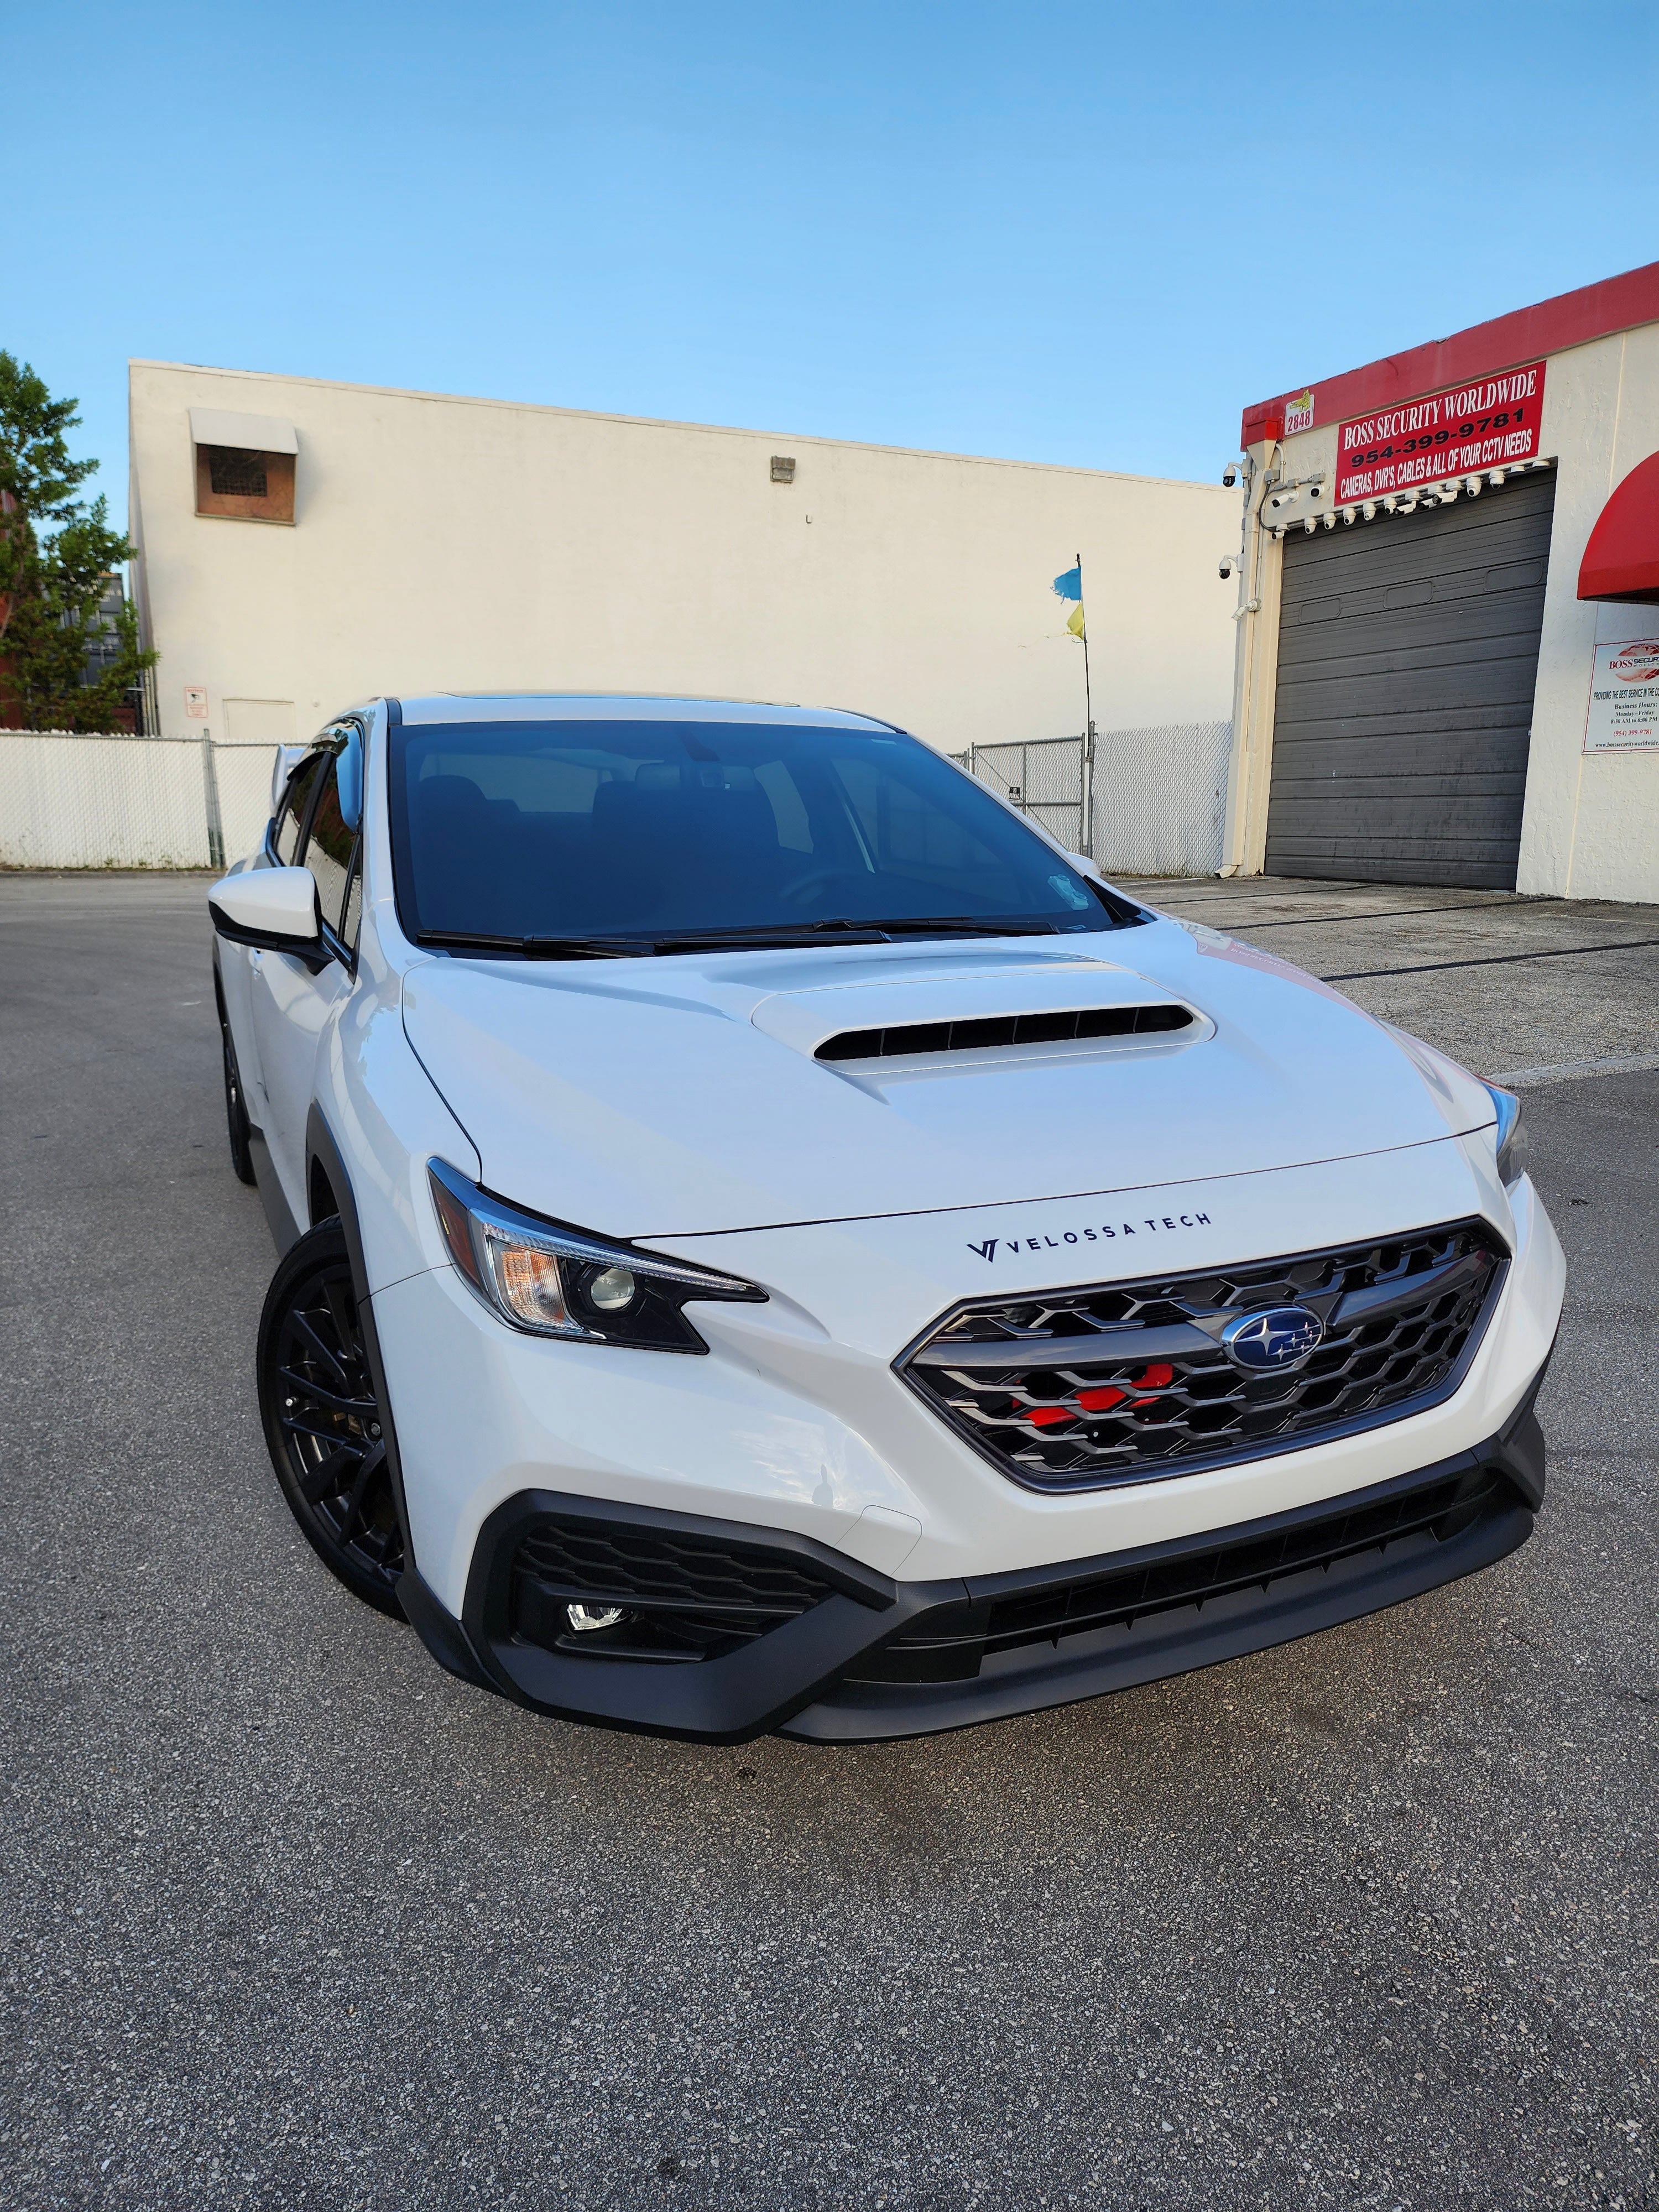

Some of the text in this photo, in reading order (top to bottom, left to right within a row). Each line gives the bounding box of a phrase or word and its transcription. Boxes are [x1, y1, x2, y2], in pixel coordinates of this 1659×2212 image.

[1287, 410, 1311, 432] 2848
[1344, 370, 1537, 450] BOSS SECURITY WORLDWIDE
[1351, 408, 1524, 468] 954-399-9781
[1340, 428, 1532, 499] CAMERAS, DVR'S, CABLES & ALL OF YOUR CCTV NEEDS
[1609, 659, 1633, 669] BOSS
[1593, 691, 1611, 700] PROVIDING
[1619, 690, 1628, 698] BEST
[1629, 688, 1643, 698] SERVICE
[1644, 688, 1647, 697] IN
[1006, 1223, 1136, 1253] VELOSSA
[1144, 1213, 1212, 1232] TECH
